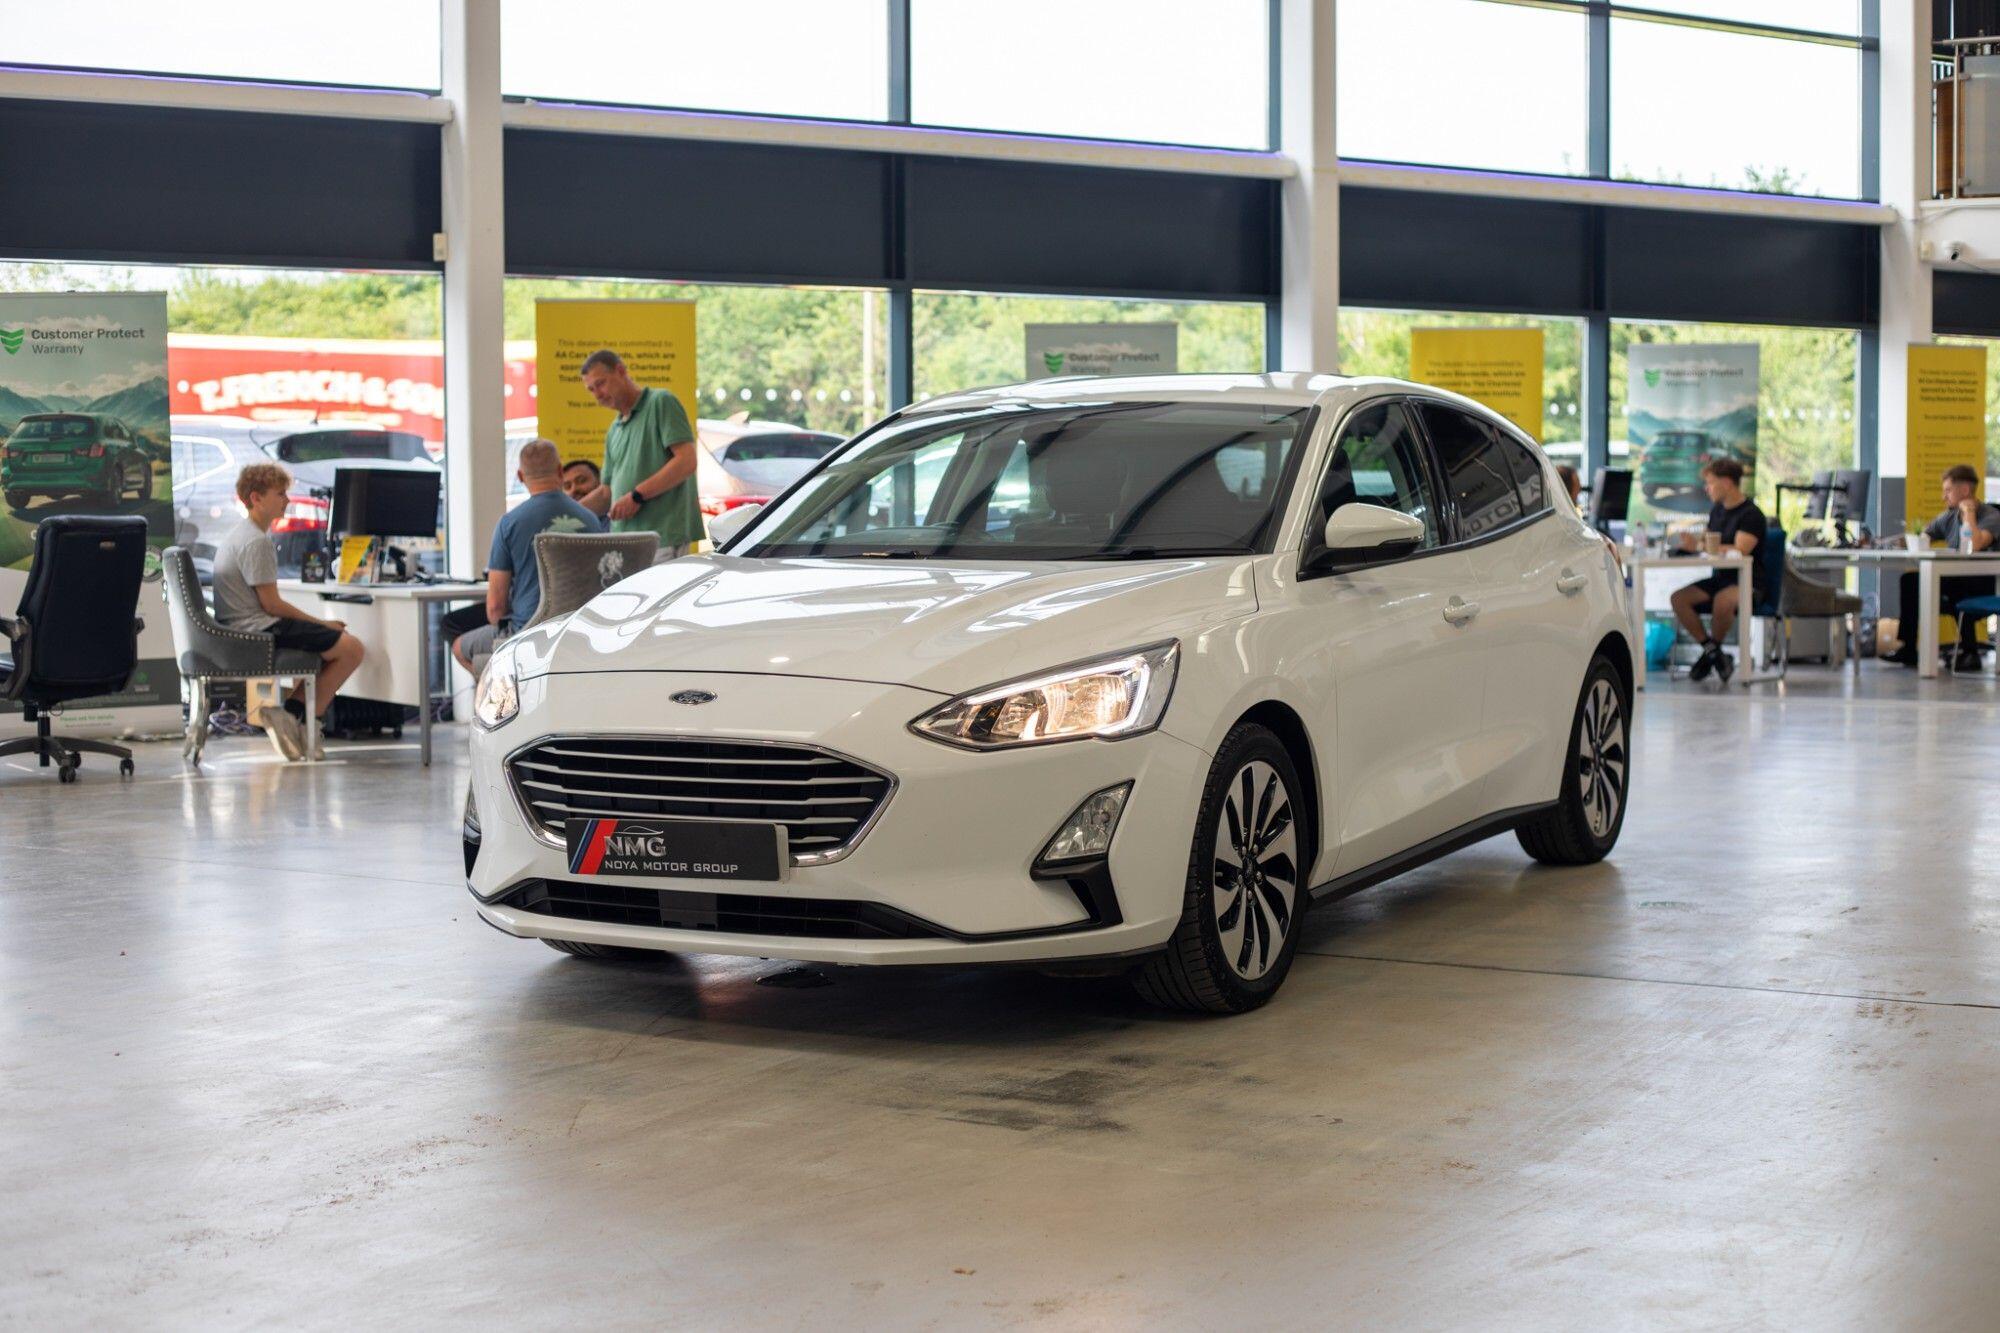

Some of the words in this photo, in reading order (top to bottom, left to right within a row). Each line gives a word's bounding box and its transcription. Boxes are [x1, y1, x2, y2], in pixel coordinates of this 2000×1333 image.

[31, 329, 93, 339] Customer
[97, 328, 145, 338] Protect
[32, 344, 84, 355] Warranty
[555, 351, 567, 359] AA
[636, 351, 660, 359] which
[603, 836, 667, 857] NMG
[604, 860, 638, 870] NOYA
[643, 861, 689, 872] MOTOR
[693, 862, 739, 873] GROUP
